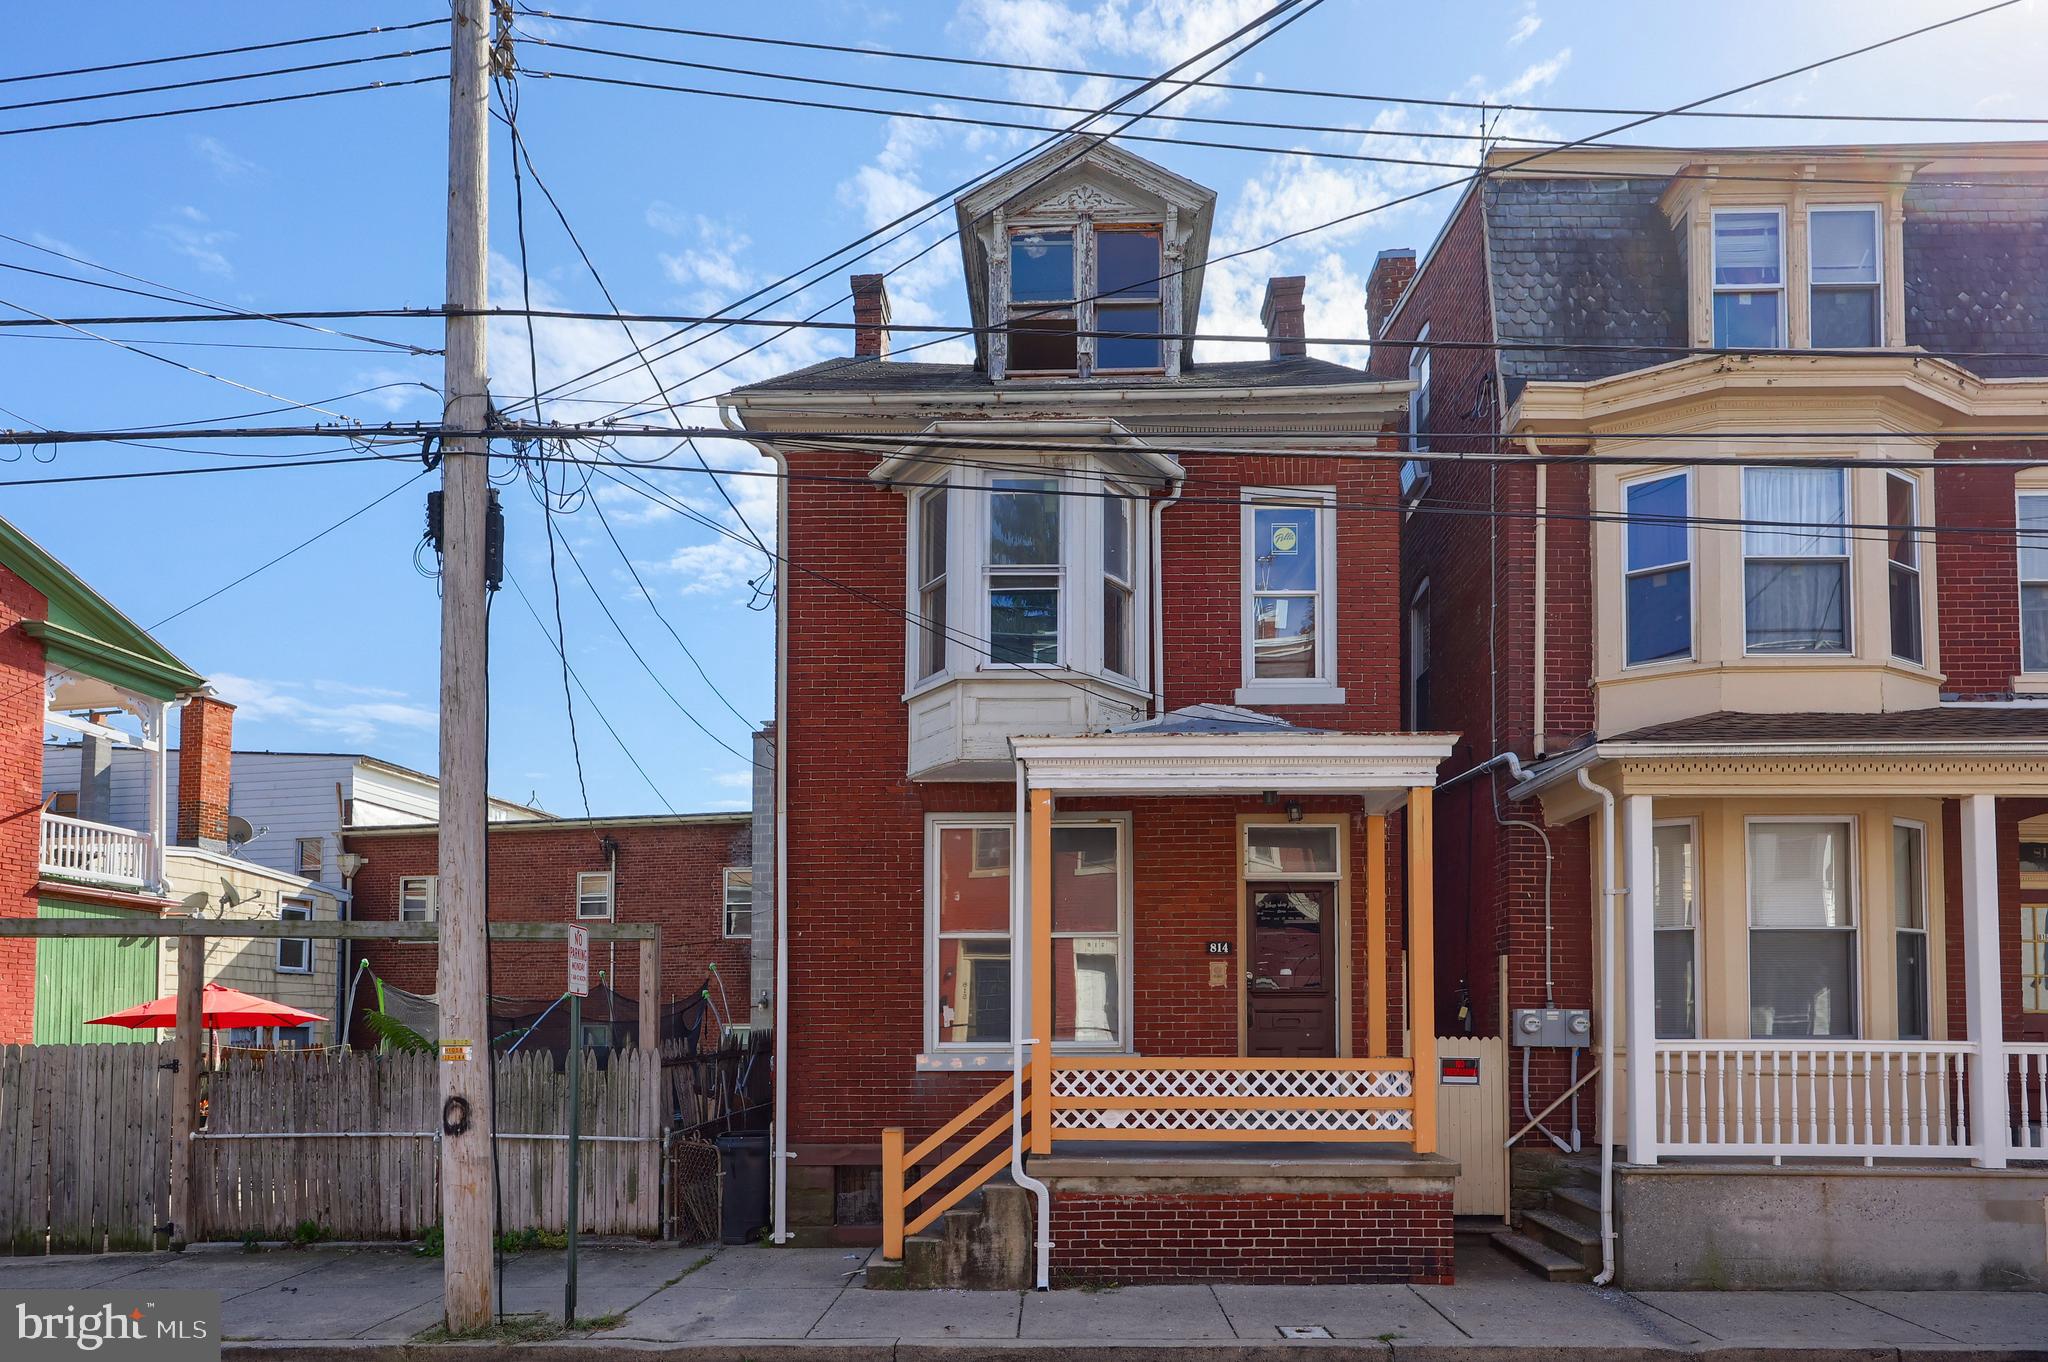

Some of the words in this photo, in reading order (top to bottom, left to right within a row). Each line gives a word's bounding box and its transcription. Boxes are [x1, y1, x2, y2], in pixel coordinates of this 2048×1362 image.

[575, 933, 583, 946] NO
[570, 946, 587, 961] PARKING
[1210, 943, 1229, 953] 814
